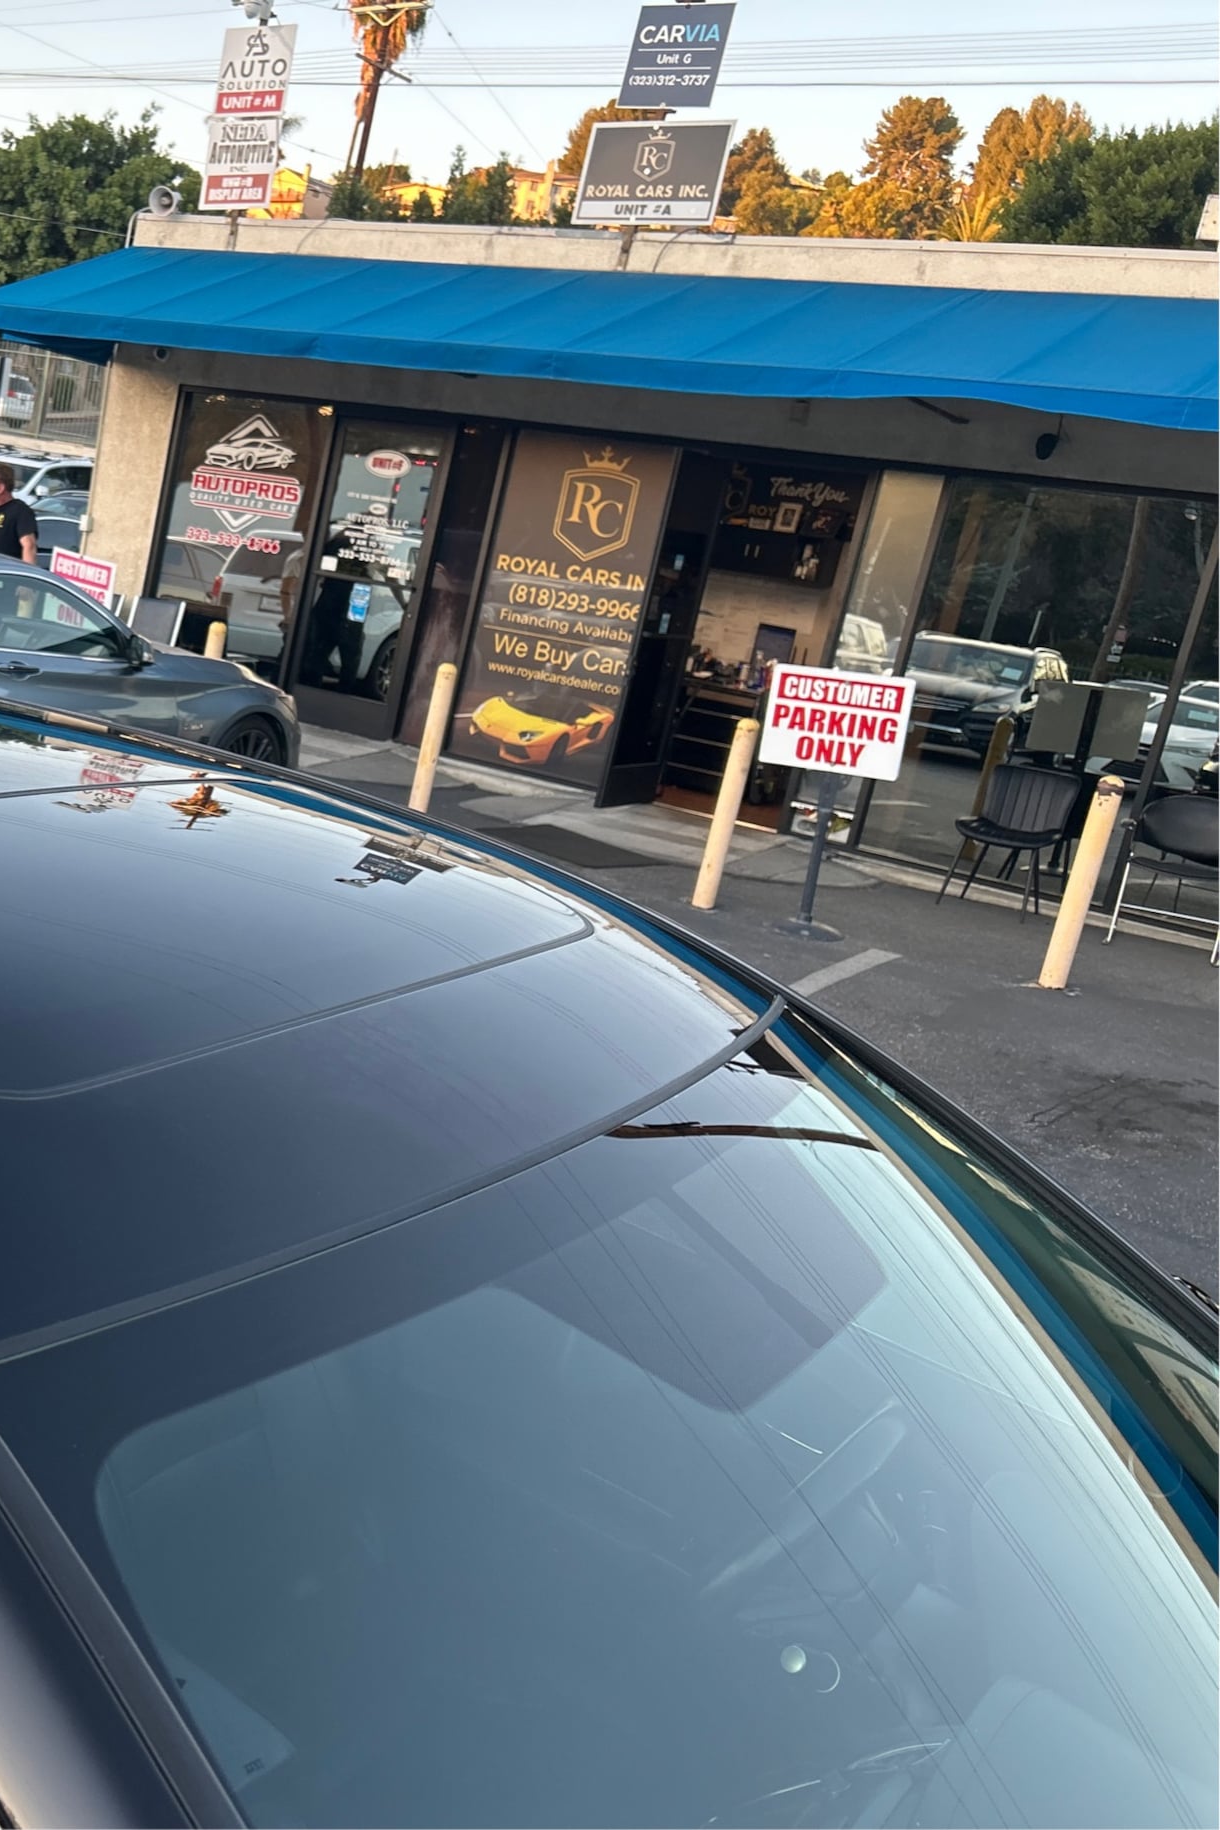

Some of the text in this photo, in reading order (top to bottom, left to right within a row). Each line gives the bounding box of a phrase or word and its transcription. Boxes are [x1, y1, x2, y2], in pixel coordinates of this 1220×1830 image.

[640, 24, 720, 44] CARVIA
[221, 58, 287, 79] AUTO
[657, 53, 692, 64] Unit G
[218, 80, 287, 91] SOLUTION
[629, 74, 711, 86] (323)312-3737
[208, 141, 276, 164] AUTOMOTIVE
[586, 185, 709, 198] ROYAL CARS INC.
[614, 204, 647, 215] UNIT
[189, 491, 298, 513] QUALITY USED CARS
[193, 474, 300, 503] AUTOPROS
[770, 477, 811, 501] Thank
[810, 482, 849, 507] You
[565, 481, 623, 538] RC
[187, 527, 280, 554] 323-533-8766
[57, 556, 108, 585] CUSTOMER
[496, 554, 560, 579] ROYAL
[566, 565, 622, 588] CARS
[509, 583, 640, 623] (818)293-9966
[499, 608, 570, 634] Financing
[494, 633, 528, 658] We
[534, 641, 578, 671] Buy
[784, 675, 898, 711] CUSTOMER
[772, 703, 899, 744] PARKING
[796, 736, 866, 768] ONLY
